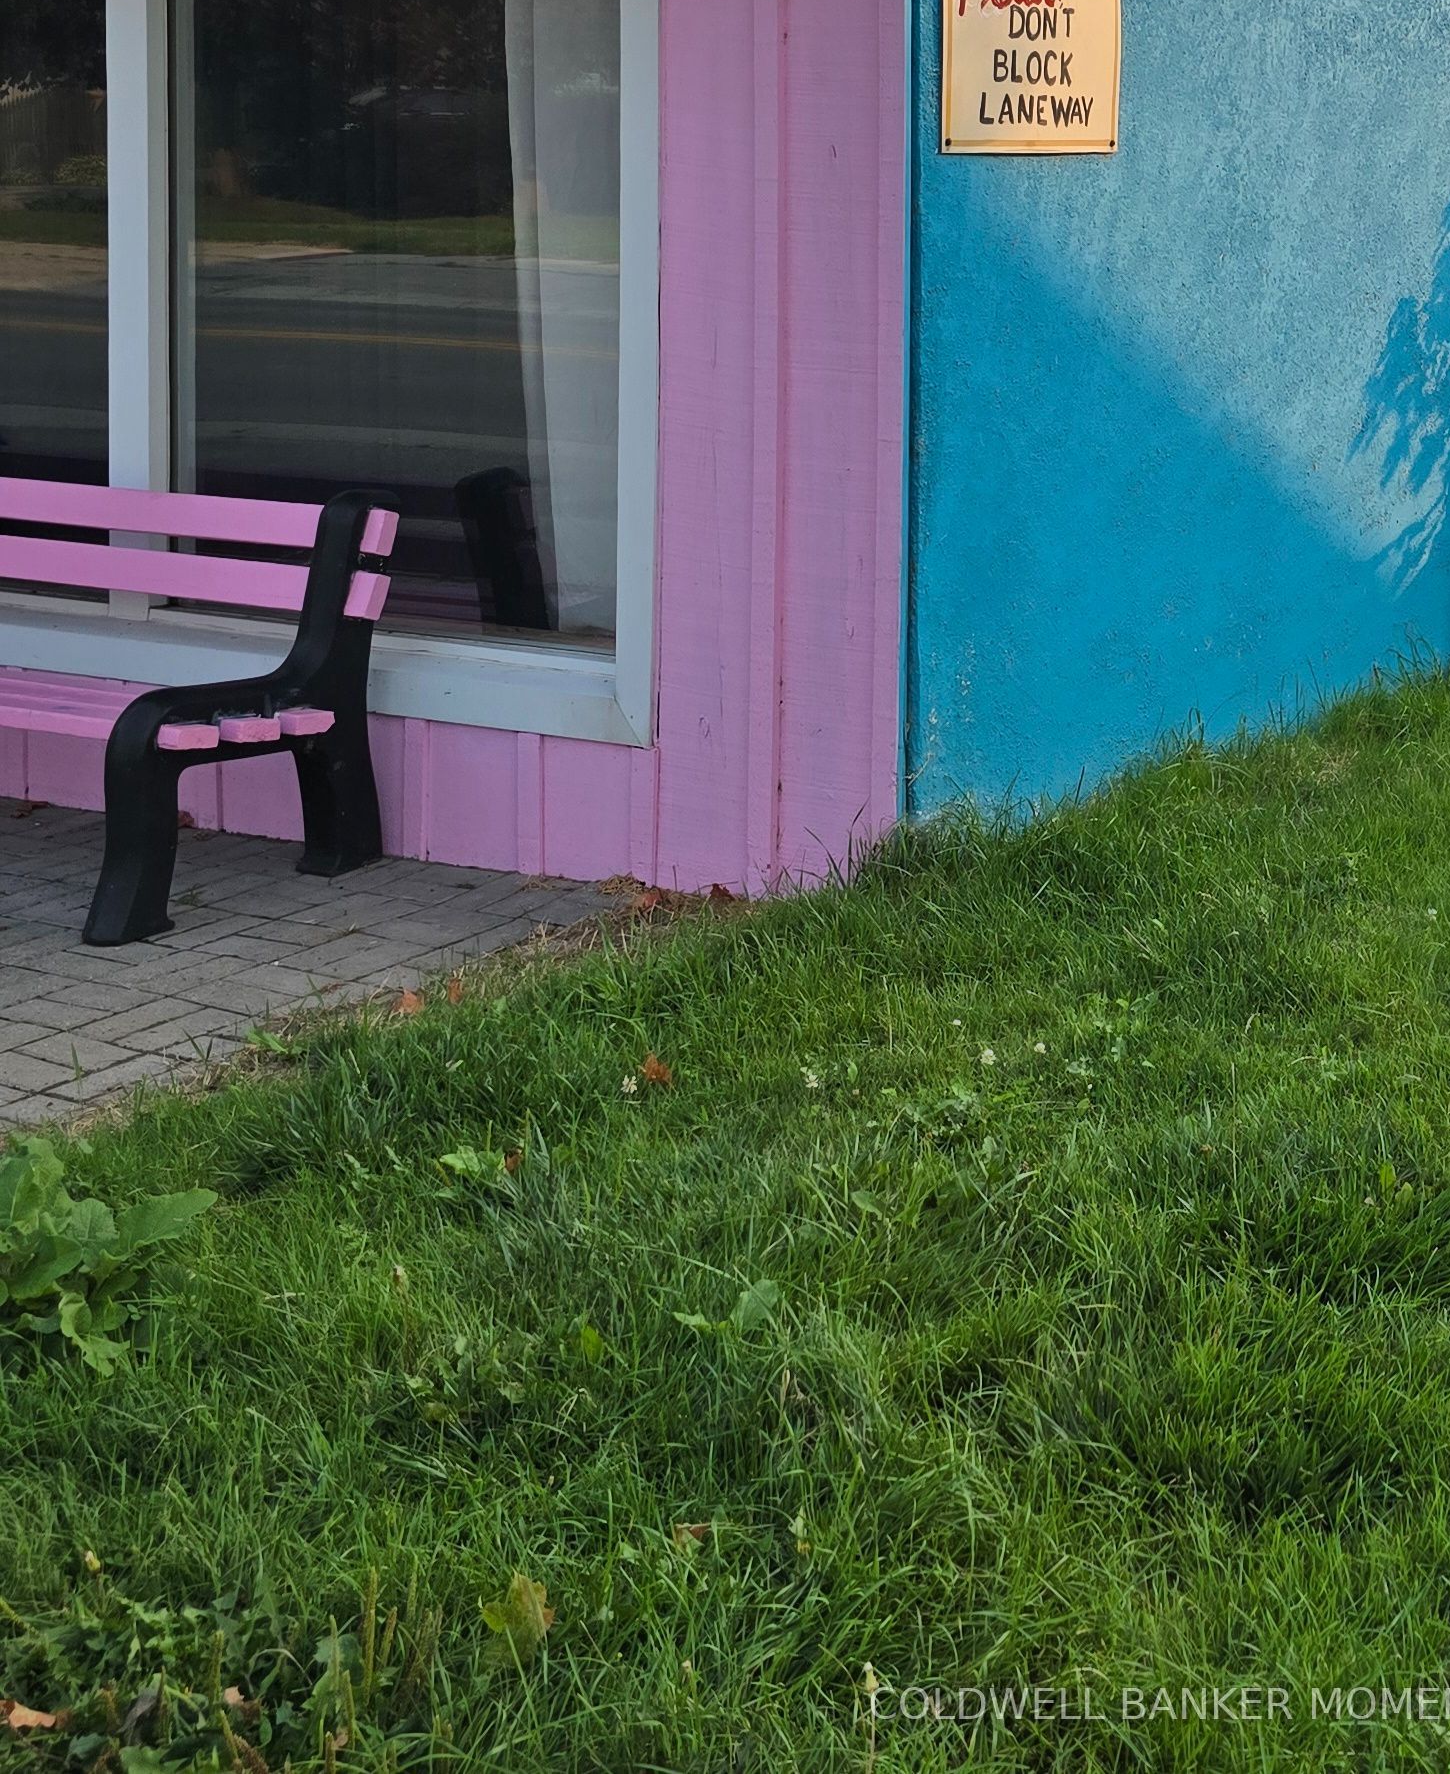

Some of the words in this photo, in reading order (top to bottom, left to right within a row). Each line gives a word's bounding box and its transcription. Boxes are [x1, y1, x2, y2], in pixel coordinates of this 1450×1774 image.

[1008, 3, 1075, 41] DON'T
[993, 48, 1074, 87] BLOCK
[979, 91, 1094, 127] LANEWAY
